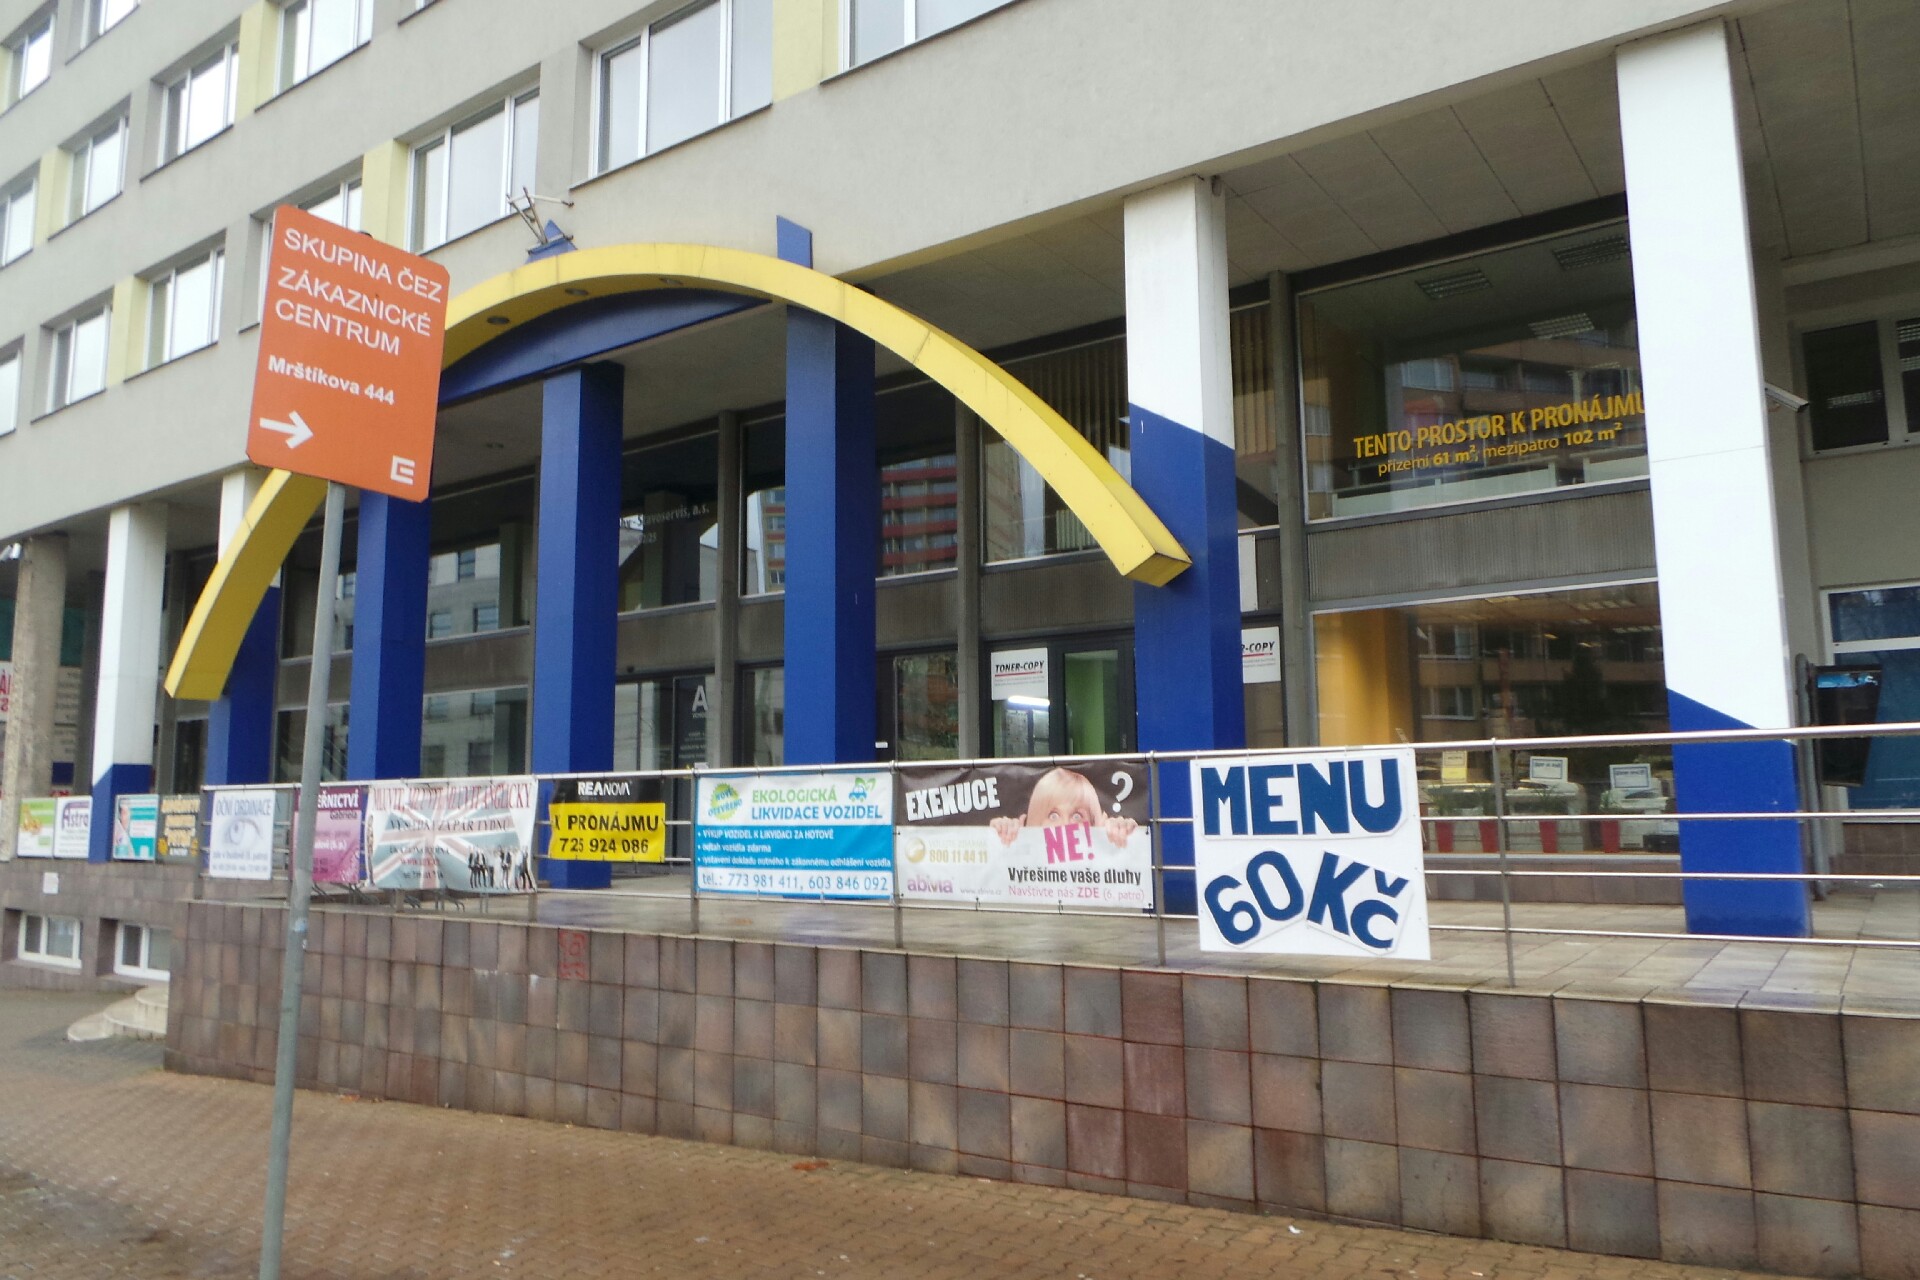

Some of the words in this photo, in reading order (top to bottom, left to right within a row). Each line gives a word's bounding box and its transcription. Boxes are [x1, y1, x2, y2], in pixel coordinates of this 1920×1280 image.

[284, 228, 392, 284] SKUPINA
[397, 267, 442, 303] ČEZ
[278, 266, 431, 336] ZÁKAZNICKÉ
[275, 299, 400, 356] CENTRUM
[364, 384, 395, 405] 444
[1353, 430, 1411, 459] TENTO
[1417, 414, 1506, 449] PROSTOR
[1511, 410, 1526, 434] K
[1433, 451, 1450, 466] 61
[1483, 437, 1559, 458] mezipatro
[1564, 430, 1594, 446] 102
[995, 660, 1044, 673] TONER-COPY
[752, 784, 837, 804] EKOLOGICKÁ
[905, 776, 1001, 822] EXEKUCE
[1201, 758, 1402, 836] MENU
[568, 811, 659, 832] PRONÁJMU
[752, 806, 819, 820] LIKVIDACE
[823, 805, 883, 819] VOZIDEL
[794, 829, 804, 839] ZA
[1043, 821, 1095, 865] NE!
[560, 838, 583, 852] 725
[589, 838, 617, 854] 924
[621, 838, 649, 854] 086
[929, 849, 949, 863] 800
[728, 873, 749, 887] 773
[753, 874, 773, 888] 981
[808, 876, 831, 890] 603
[836, 876, 860, 890] 846
[864, 876, 888, 891] 092
[907, 874, 953, 893] abivia
[1008, 866, 1067, 884] Vyřešíme
[1070, 868, 1101, 884] vaše
[1104, 869, 1141, 886] dluhy
[1057, 886, 1074, 898] nás
[1077, 887, 1100, 899] ZDE
[1204, 850, 1304, 945] 60
